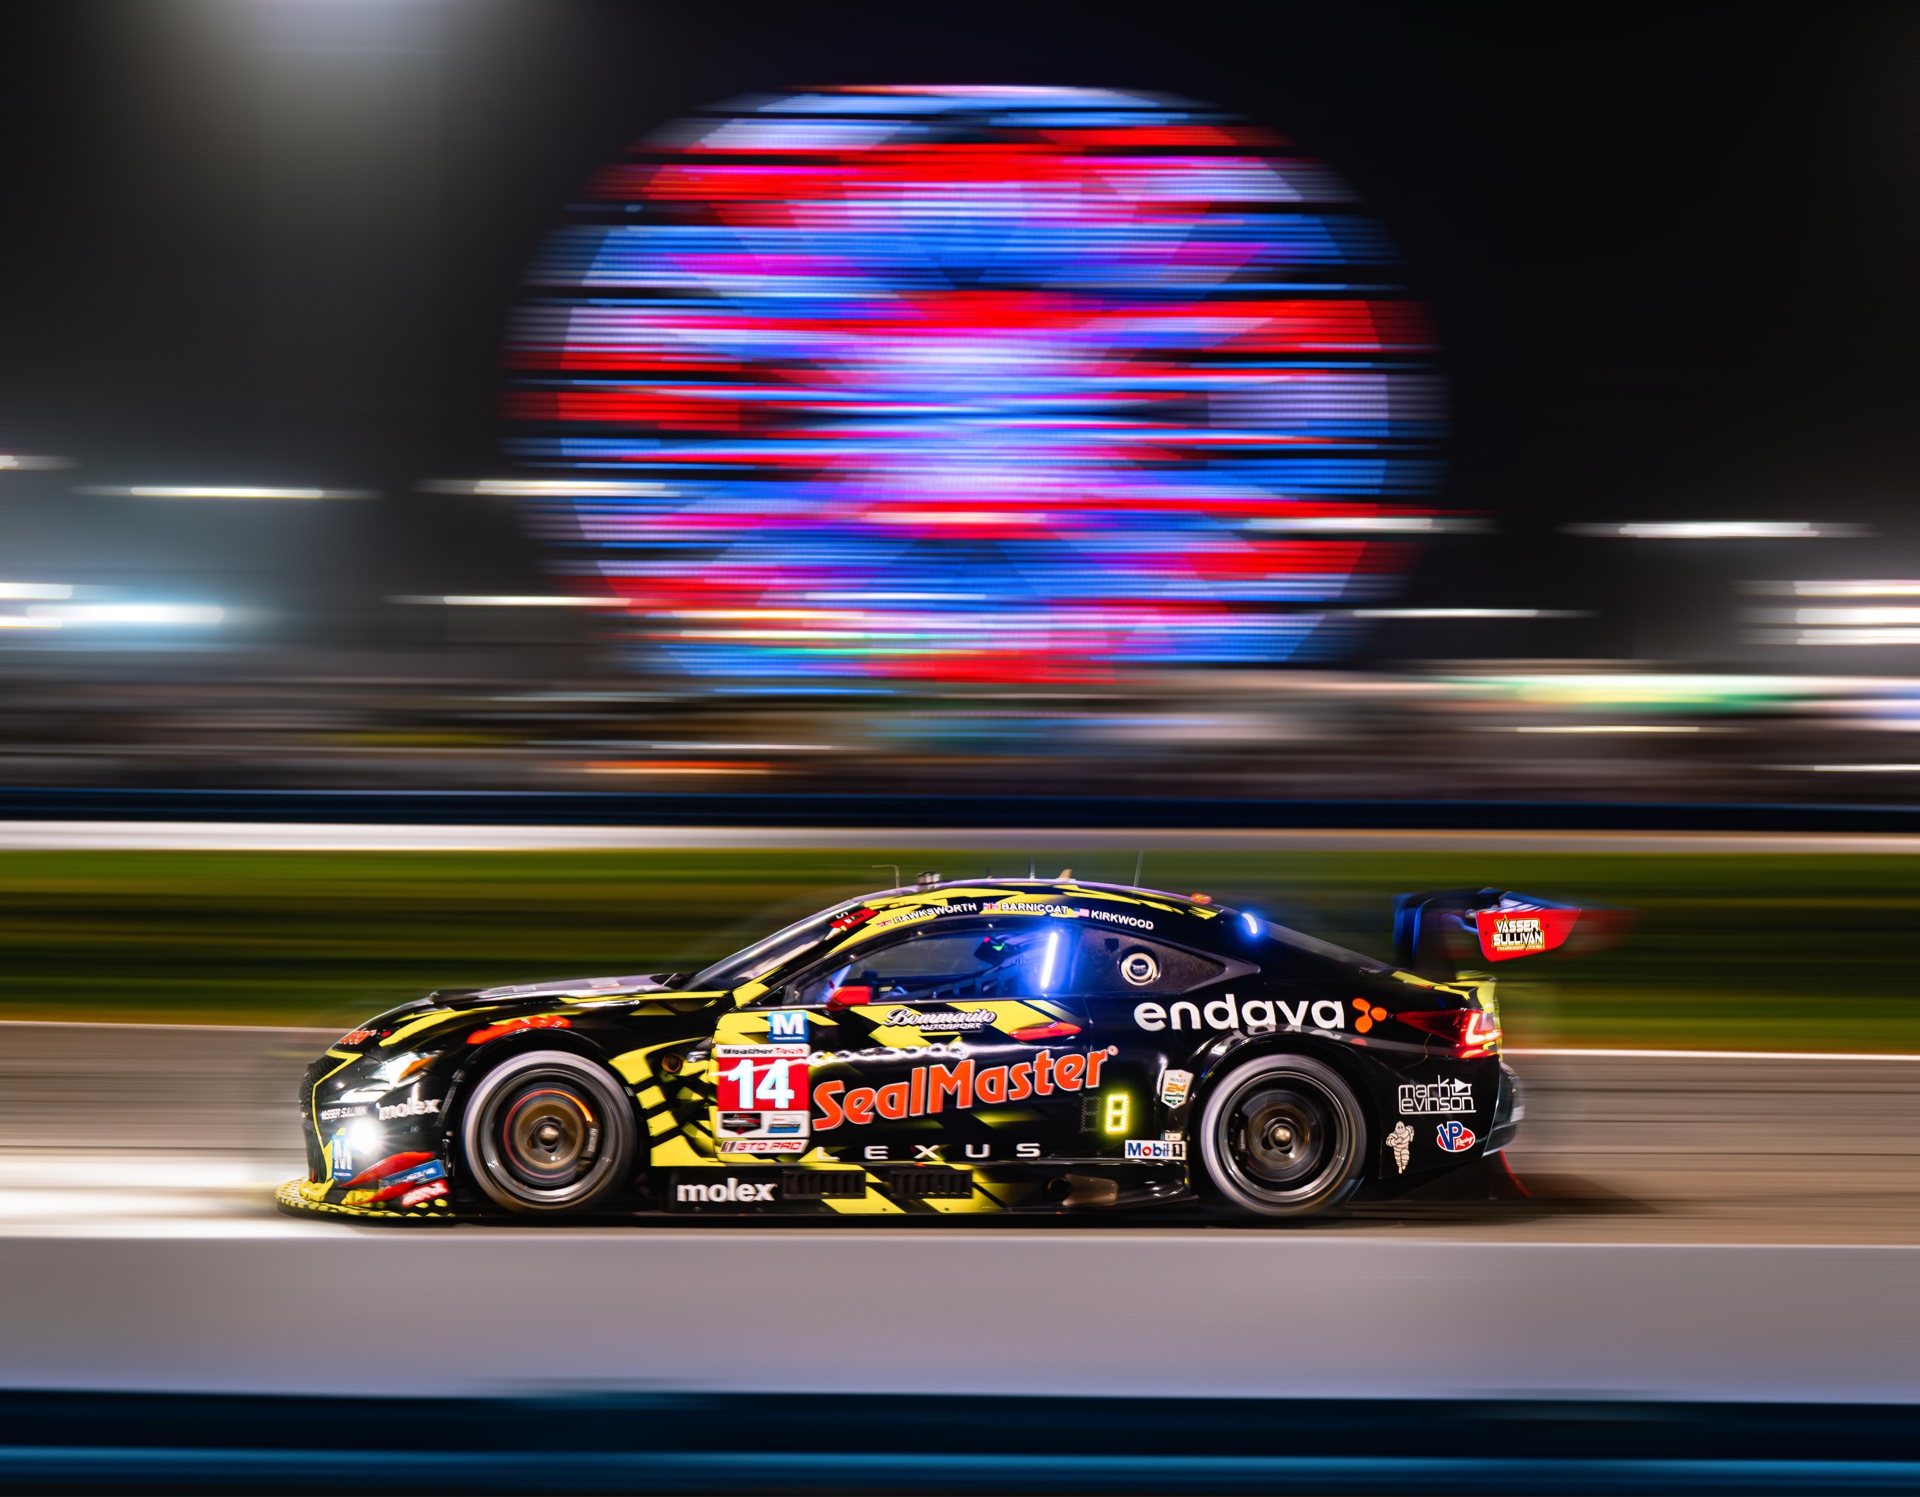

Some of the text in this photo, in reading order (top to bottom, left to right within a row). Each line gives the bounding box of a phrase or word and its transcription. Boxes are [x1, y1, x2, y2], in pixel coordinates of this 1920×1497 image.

[893, 902, 977, 923] HAWKSWORTH
[1001, 902, 1068, 916] BARNICOAT
[1091, 909, 1154, 930] KIRKWOOD
[1496, 916, 1539, 933] VASSER
[1493, 931, 1543, 947] SULLIVAN
[883, 1008, 997, 1026] Bommarito
[1133, 993, 1345, 1032] endava
[772, 1013, 805, 1036] M
[727, 1058, 795, 1109] 14
[379, 1095, 441, 1120] molex
[1104, 1093, 1130, 1134] 8
[1437, 1120, 1464, 1151] VP
[817, 1143, 1042, 1161] LEXUS
[1127, 1142, 1169, 1157] Mobil
[676, 1177, 775, 1202] molex
